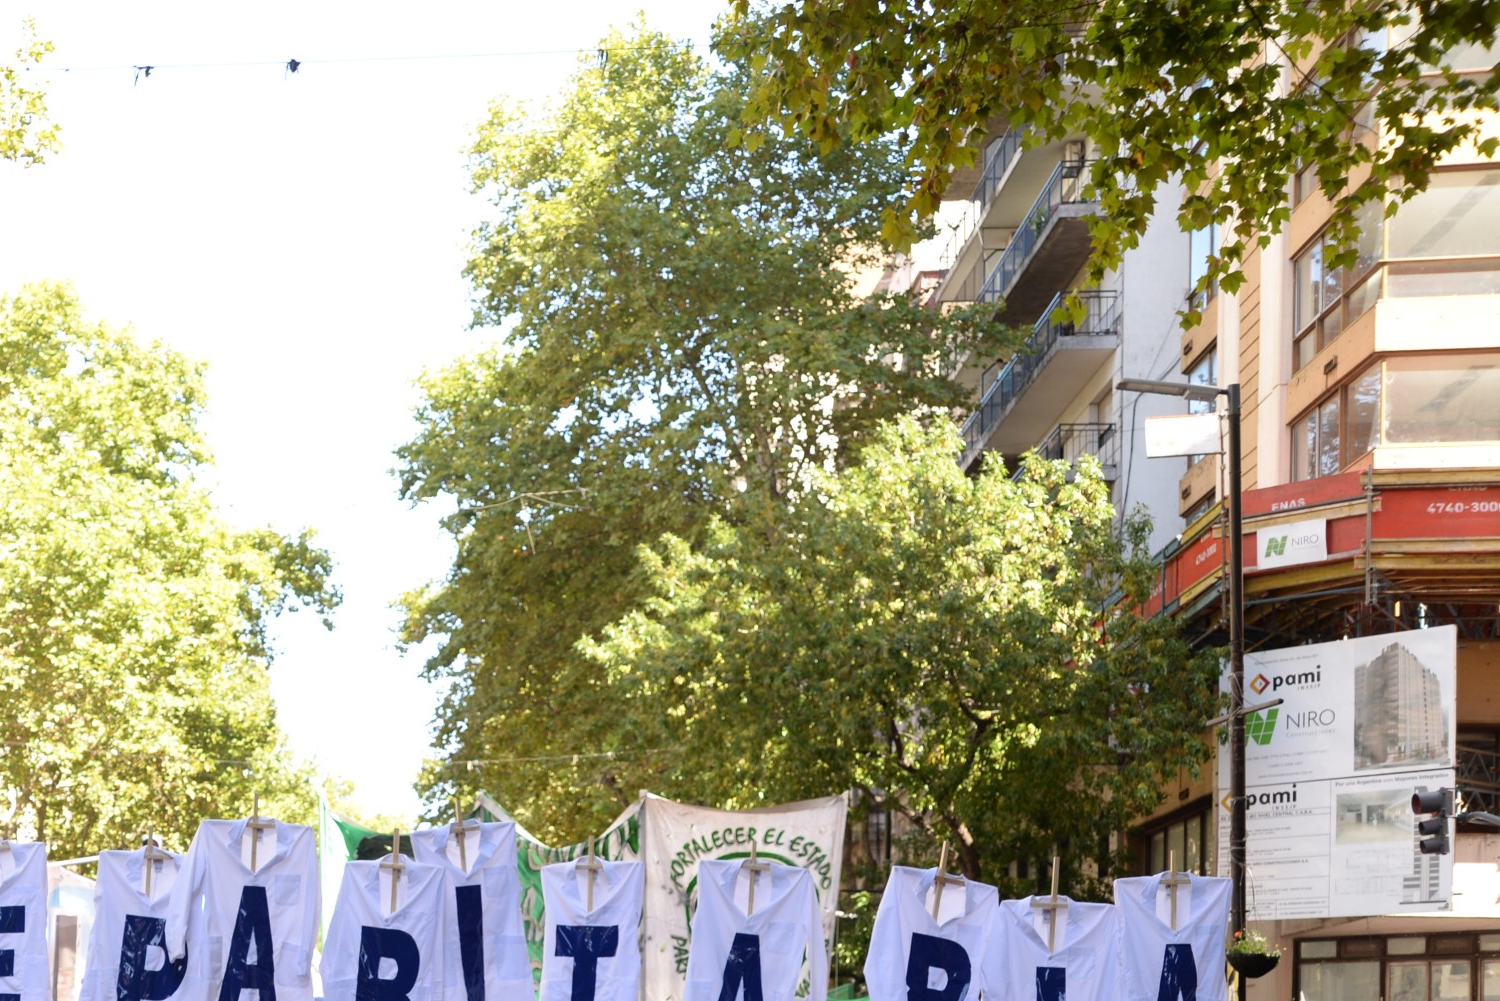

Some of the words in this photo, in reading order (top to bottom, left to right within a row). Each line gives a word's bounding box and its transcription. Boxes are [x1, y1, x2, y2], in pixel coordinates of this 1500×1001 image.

[1291, 534, 1319, 547] NIRO
[1273, 665, 1321, 691] pami
[1286, 709, 1335, 730] NIRO
[1246, 783, 1297, 810] pami
[670, 827, 757, 888] FORTALECER
[764, 828, 786, 845] EL
[789, 836, 832, 889] ESTADO
